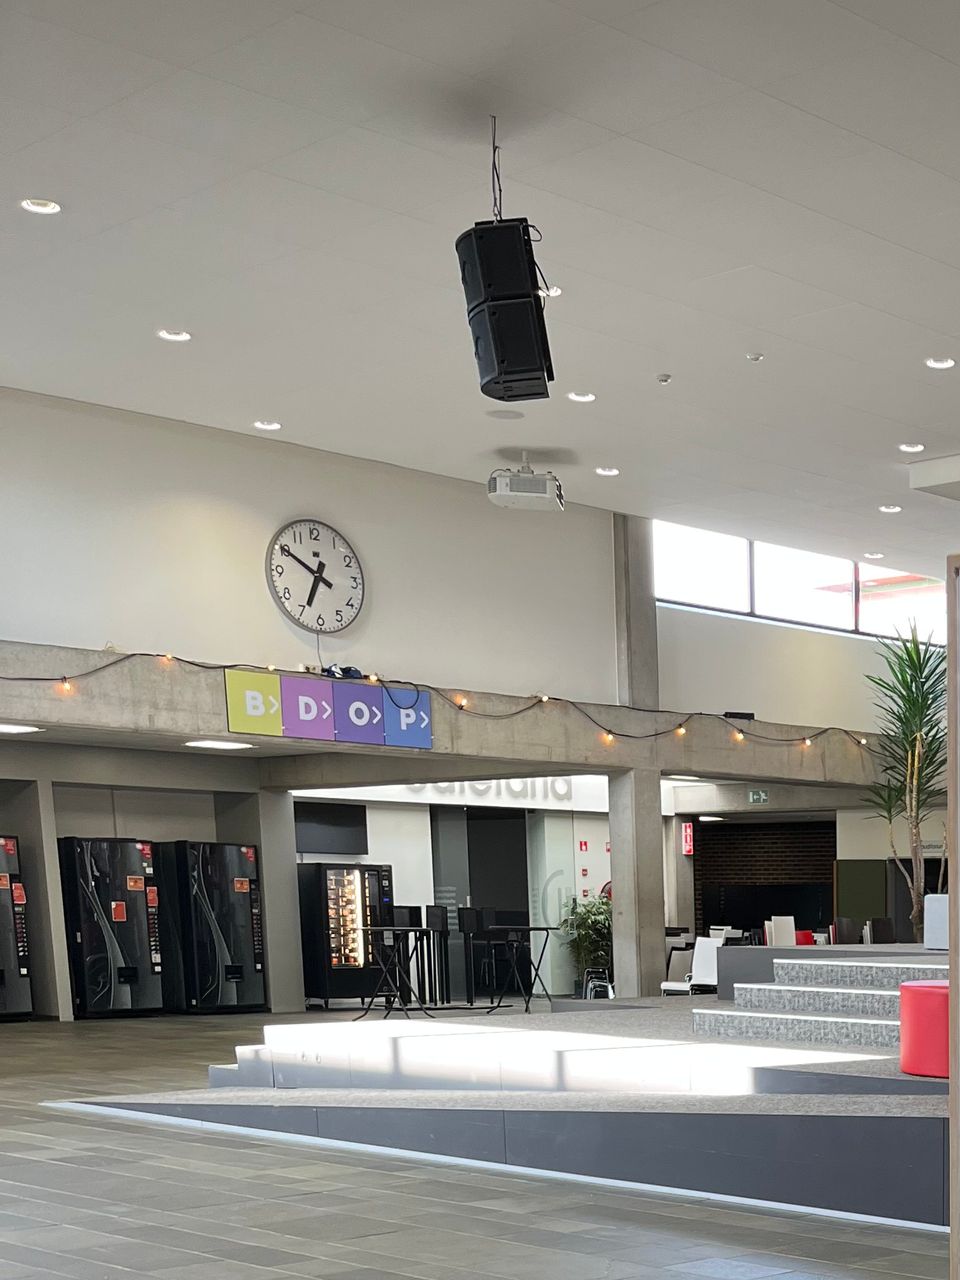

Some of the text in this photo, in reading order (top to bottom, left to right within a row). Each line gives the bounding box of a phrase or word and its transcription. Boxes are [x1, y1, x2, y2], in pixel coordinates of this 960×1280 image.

[293, 530, 302, 544] 11
[309, 527, 320, 541] 12
[344, 555, 352, 568] 2
[275, 565, 284, 577] 9
[350, 576, 358, 589] 3
[283, 587, 291, 600] 8
[346, 597, 354, 609] 4
[298, 605, 306, 617] 7
[336, 610, 343, 622] 5
[316, 614, 325, 626] 6
[245, 690, 265, 716] B
[298, 696, 317, 720] D
[349, 701, 370, 726] O
[400, 708, 416, 730] P
